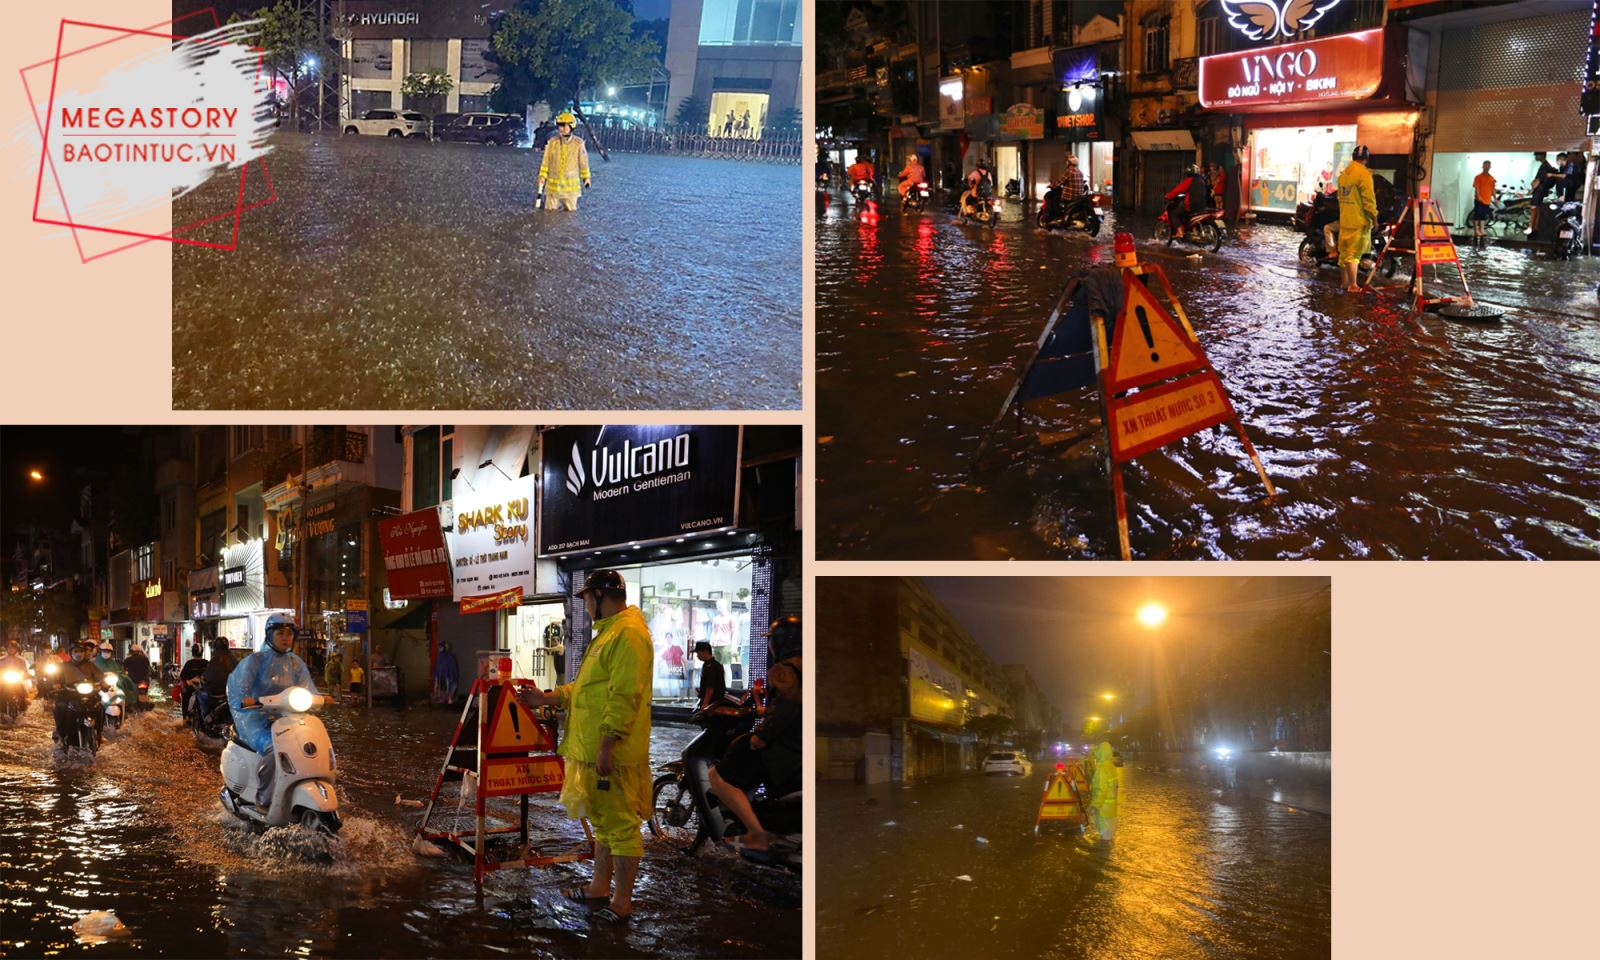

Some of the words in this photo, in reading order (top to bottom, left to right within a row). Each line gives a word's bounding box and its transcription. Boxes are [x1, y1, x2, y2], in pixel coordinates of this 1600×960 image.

[361, 12, 419, 25] HYUNDAI
[1269, 80, 1286, 96] NỘI
[1286, 81, 1295, 93] Y
[1305, 77, 1337, 91] BIKINI
[1122, 417, 1138, 435] XN
[1206, 390, 1215, 404] 3
[592, 433, 690, 487] Vulcano
[593, 485, 629, 501] Modern
[633, 470, 691, 492] Gentleman
[458, 504, 504, 532] SHARK
[507, 497, 529, 521] KU
[680, 516, 723, 529] VULCANO.VN
[494, 523, 529, 545] Story
[515, 764, 530, 775] XN
[557, 773, 564, 782] 3
